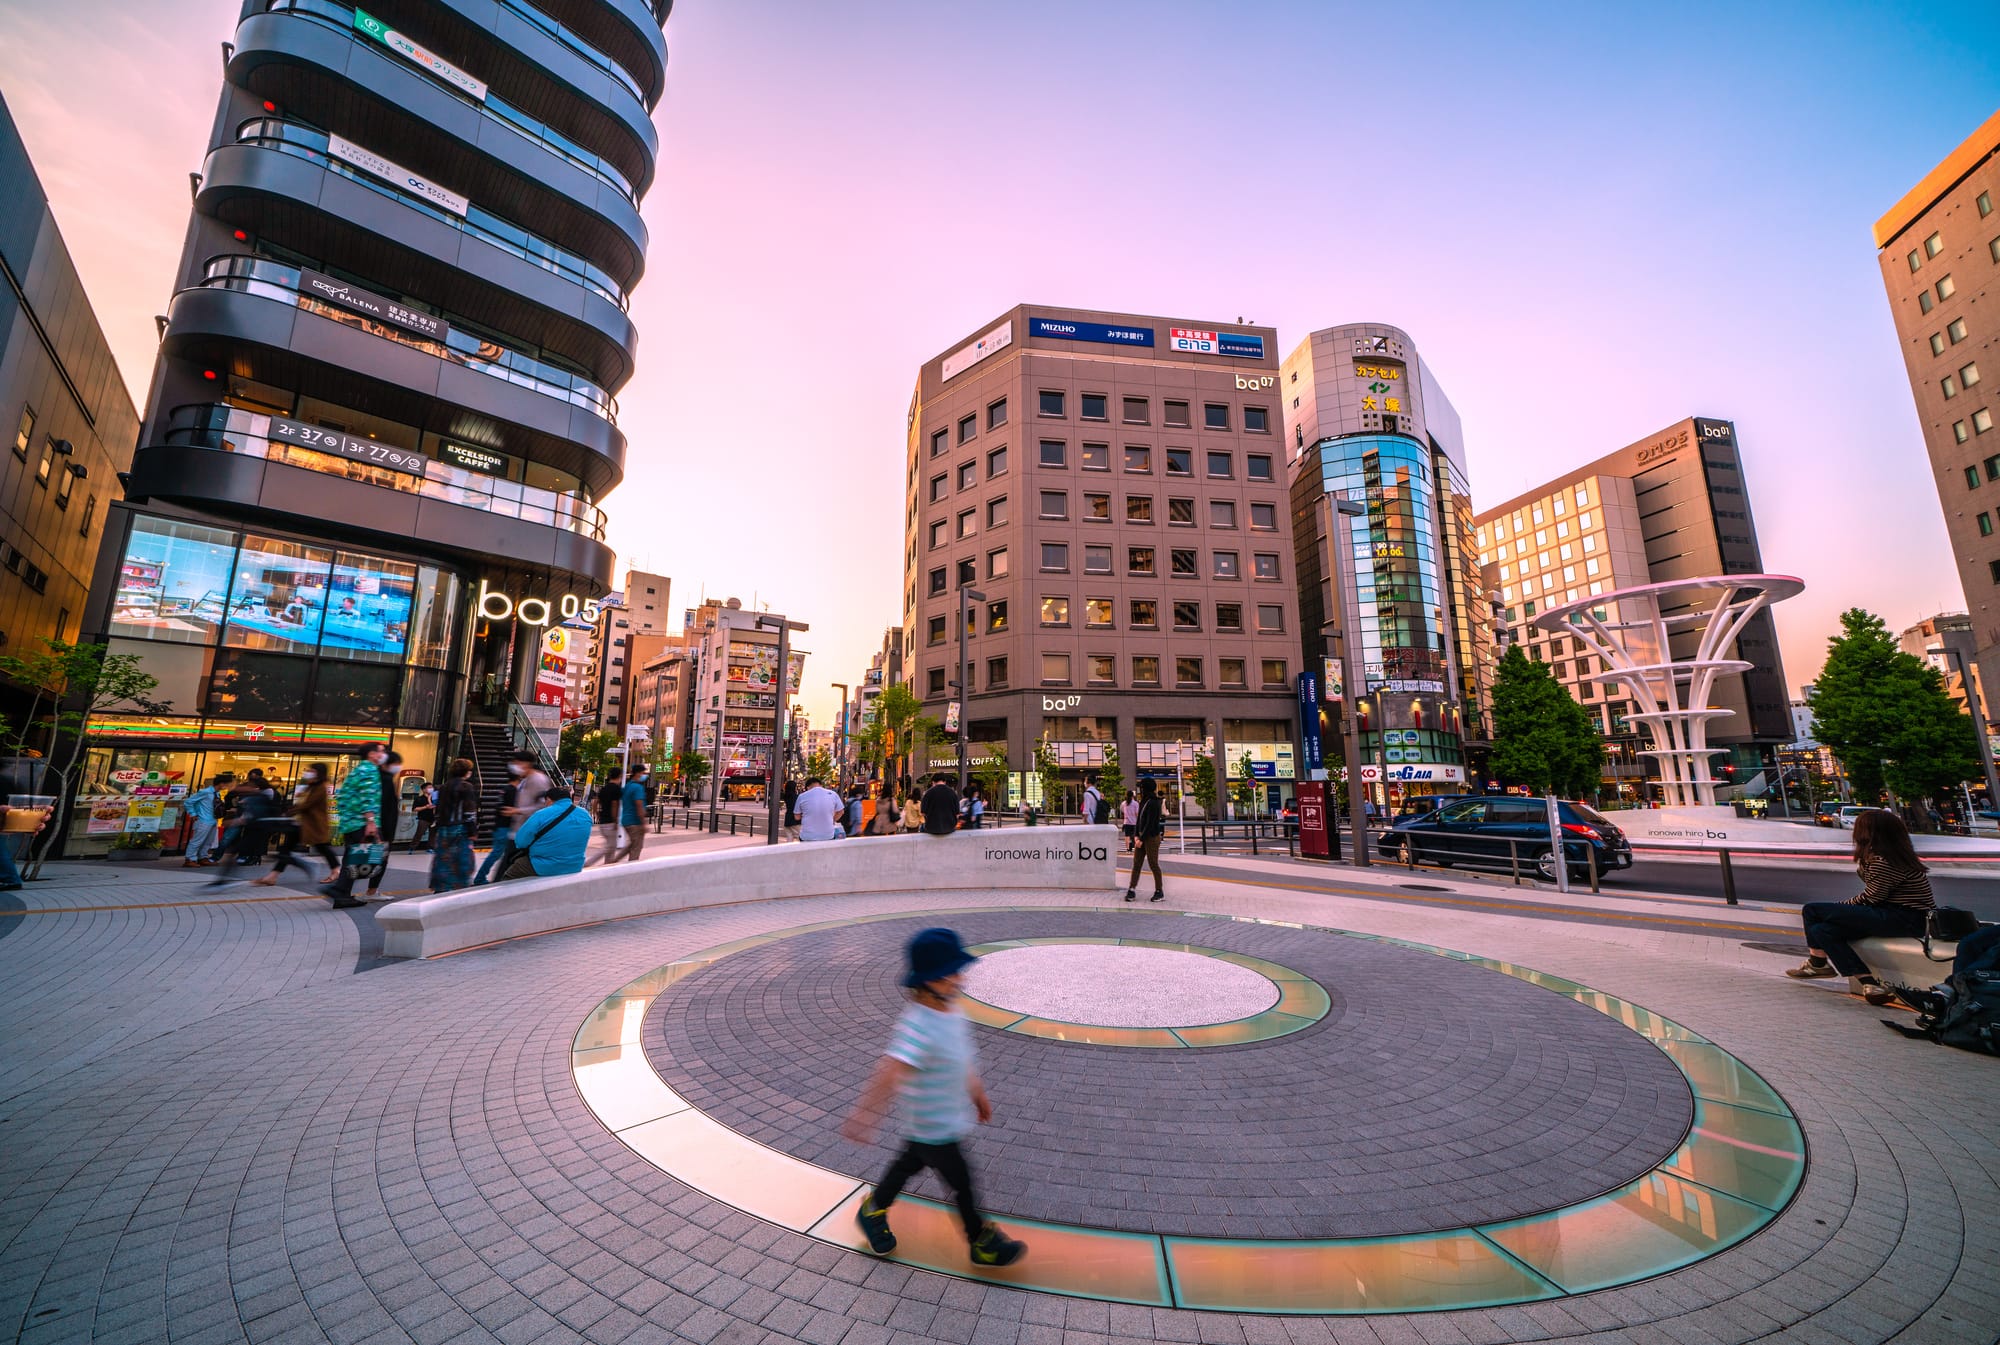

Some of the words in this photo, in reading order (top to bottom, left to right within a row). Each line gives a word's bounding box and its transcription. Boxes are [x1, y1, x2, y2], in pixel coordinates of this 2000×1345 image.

[395, 39, 477, 90] 大塚駅前クリニック
[339, 293, 379, 313] BALENA
[1041, 322, 1076, 333] MIZUHO
[1107, 330, 1144, 341] みずほ銀行
[1178, 338, 1211, 351] ena
[1356, 366, 1399, 380] カプセル
[1368, 381, 1391, 394] イン
[1361, 395, 1401, 412] 大塚
[278, 424, 295, 436] 2F
[300, 427, 323, 441] 37
[349, 442, 366, 454] 3F
[369, 445, 390, 459] 77
[447, 444, 502, 466] EXCELSIOR
[457, 455, 490, 470] CAFFÉ
[478, 579, 551, 627] ba
[560, 593, 600, 623] 05
[115, 771, 142, 780] たばこ
[1402, 765, 1433, 780] GAIA
[1648, 829, 1683, 837] ironowa
[1685, 829, 1704, 837] hiro
[1706, 828, 1727, 840] ba
[985, 846, 1041, 860] ironowa
[1045, 846, 1073, 860] hiro
[1078, 841, 1107, 861] ba
